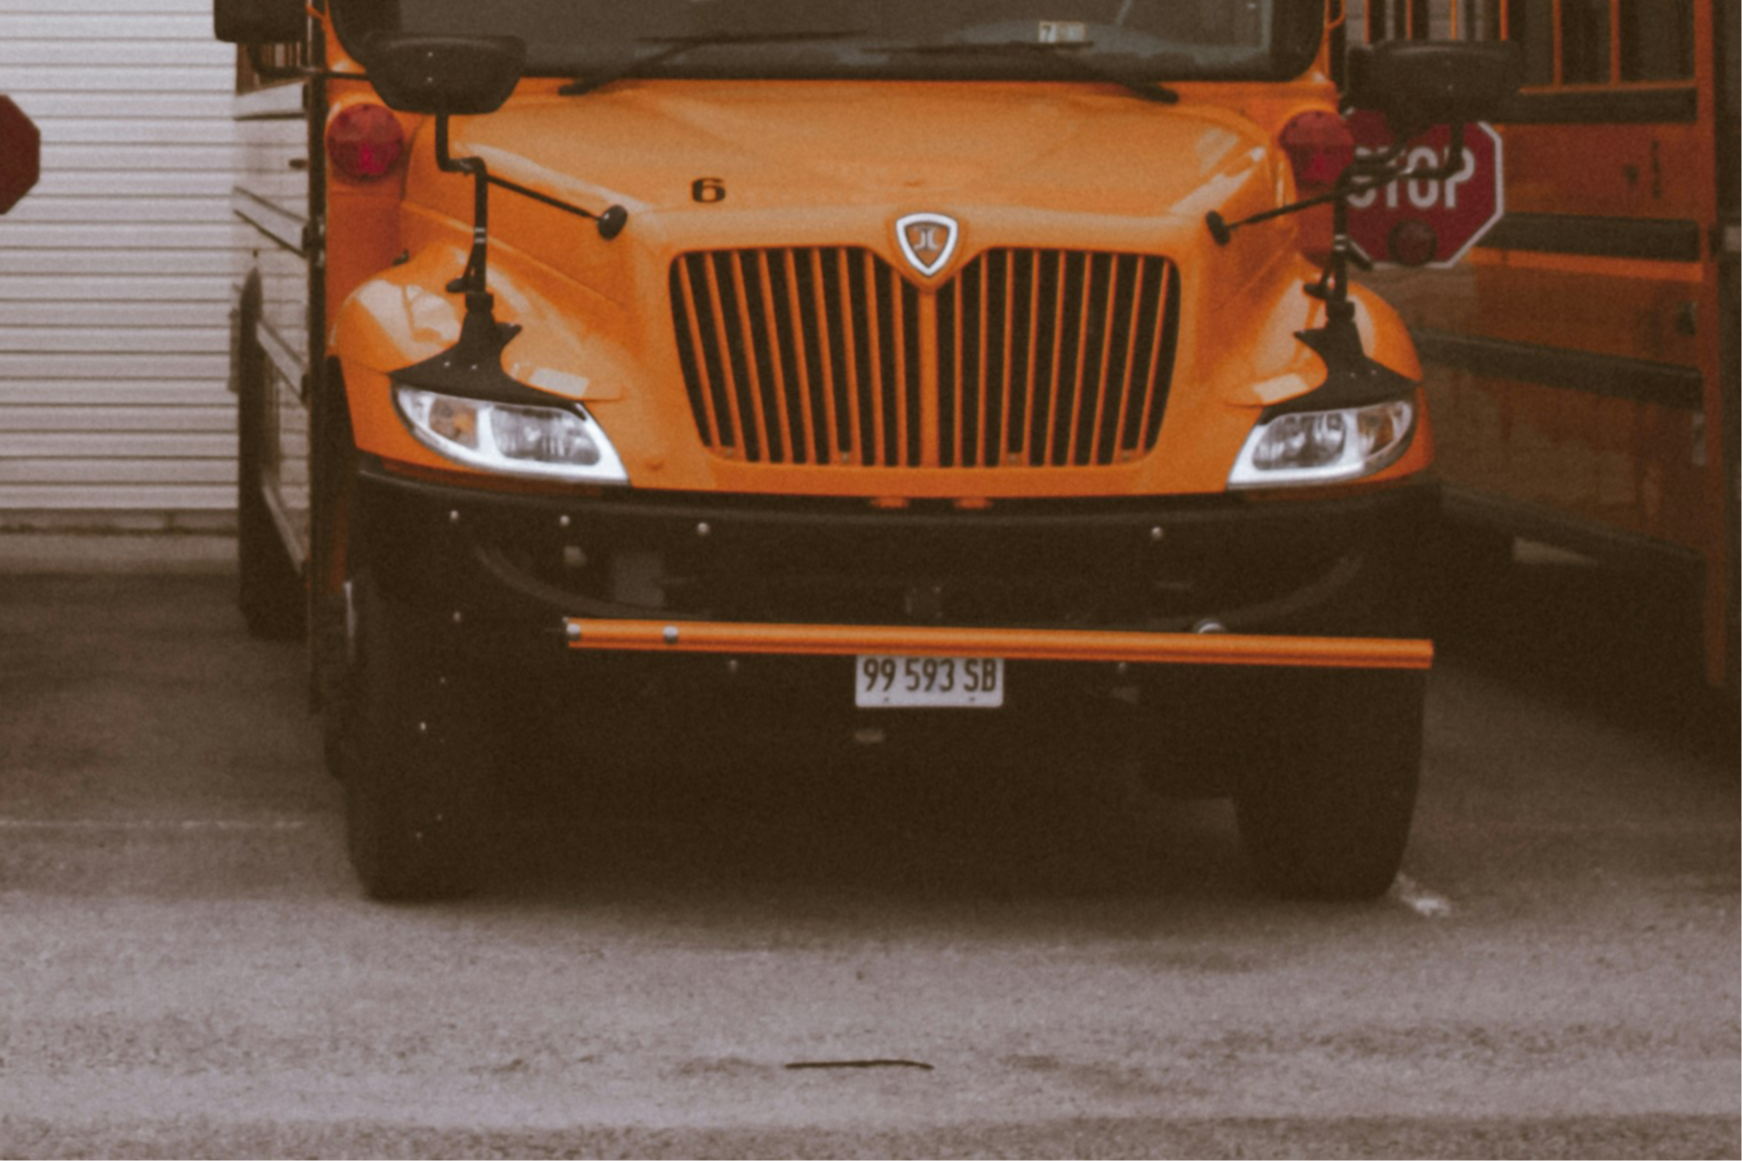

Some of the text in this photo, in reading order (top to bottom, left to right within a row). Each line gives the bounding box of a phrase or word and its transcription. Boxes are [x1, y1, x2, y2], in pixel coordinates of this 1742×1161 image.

[691, 177, 726, 203] 6
[863, 657, 997, 693] 99 593 SB
